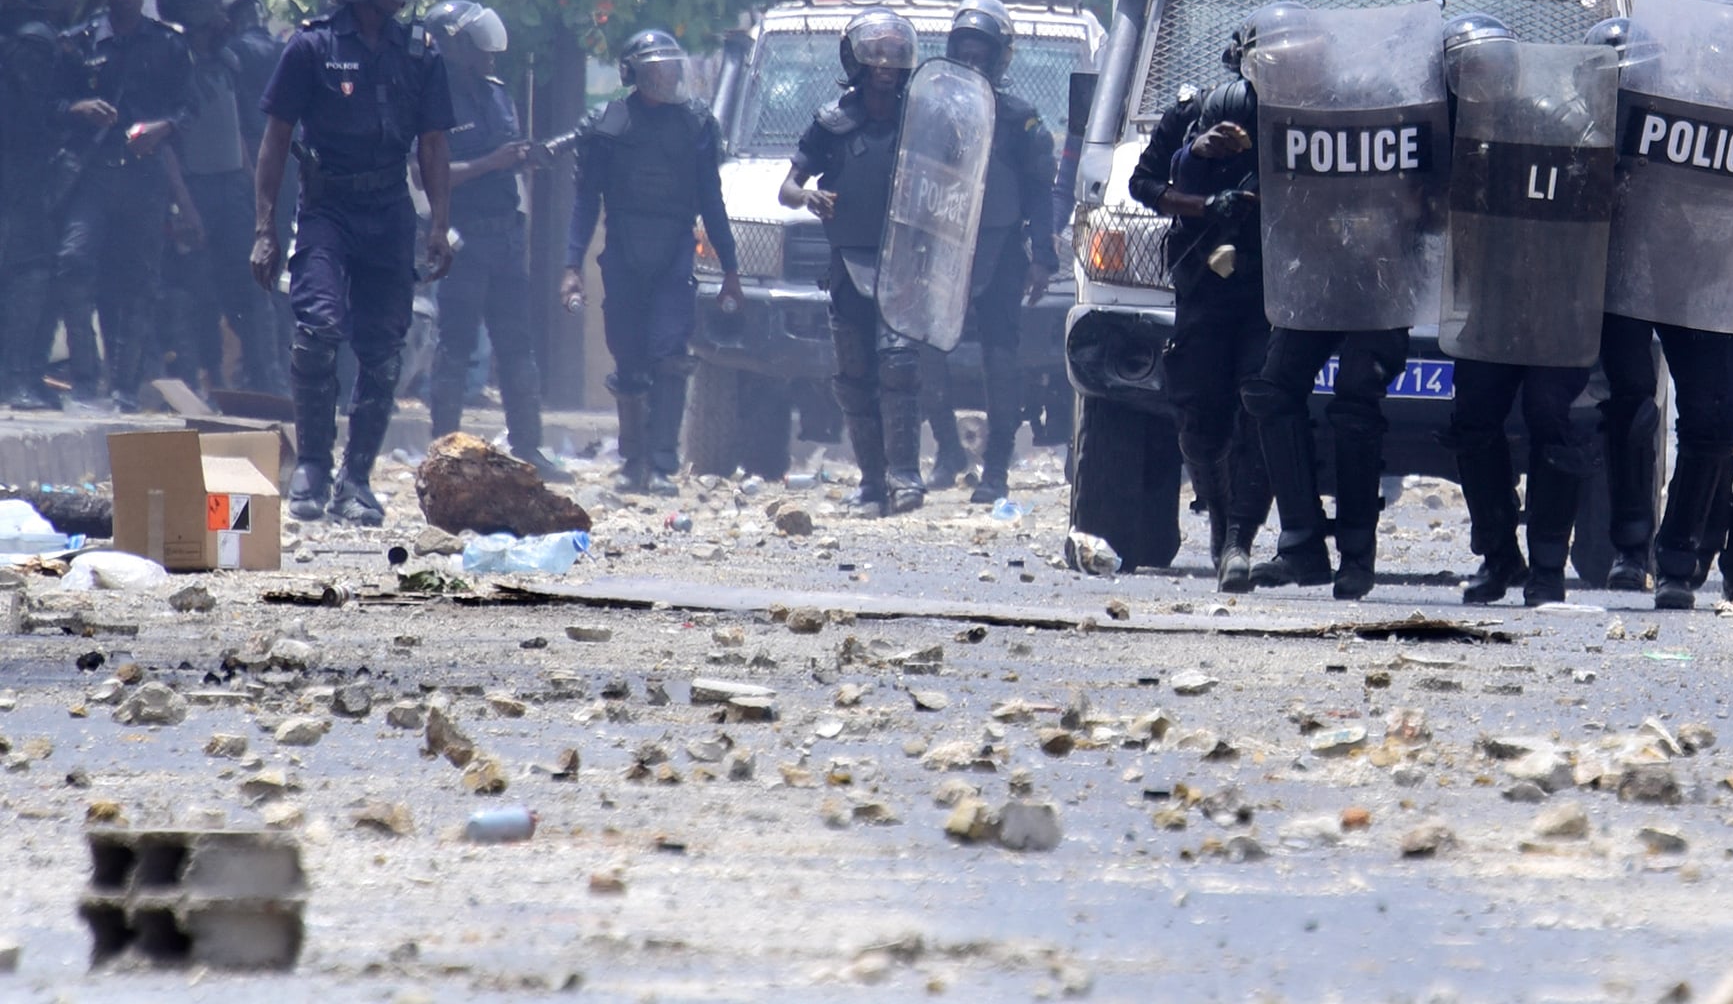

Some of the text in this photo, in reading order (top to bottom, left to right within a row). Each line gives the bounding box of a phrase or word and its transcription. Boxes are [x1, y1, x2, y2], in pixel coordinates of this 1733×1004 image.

[1286, 127, 1419, 173] POLICE
[917, 176, 970, 224] POLICE
[1527, 164, 1558, 200] LI
